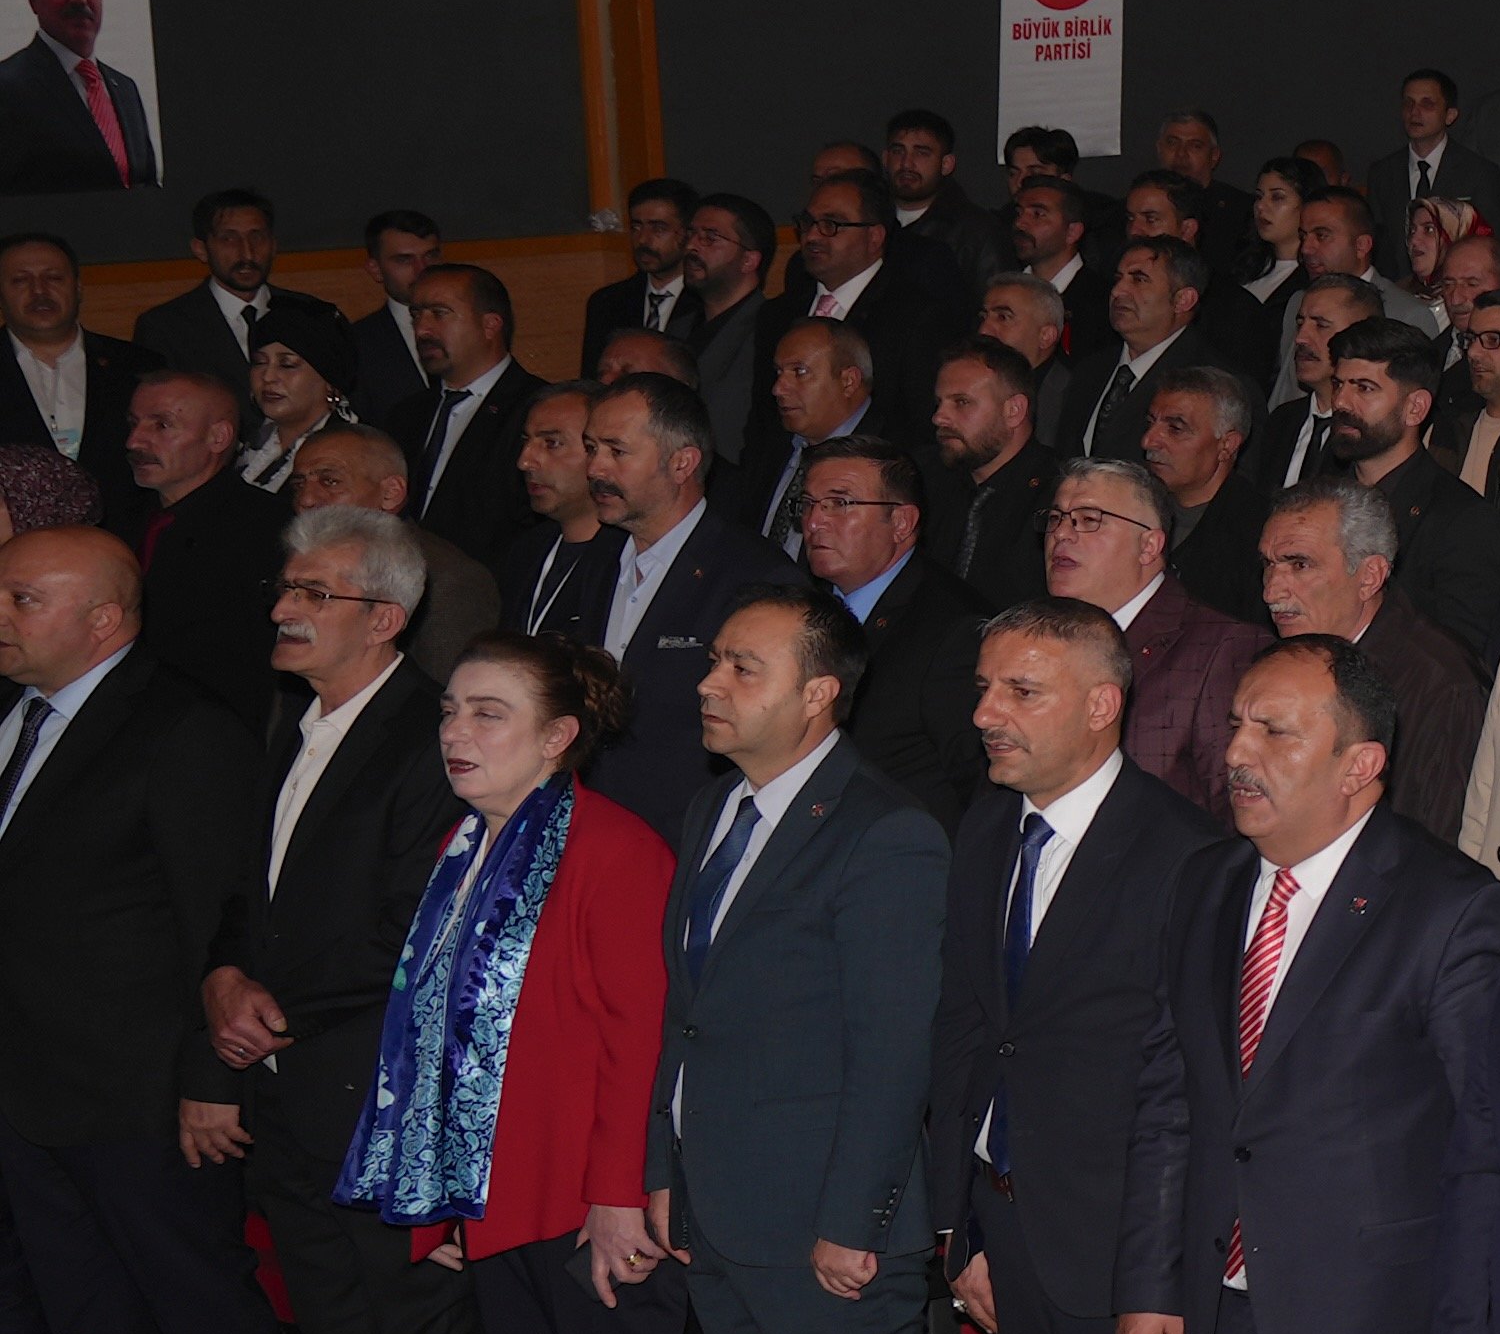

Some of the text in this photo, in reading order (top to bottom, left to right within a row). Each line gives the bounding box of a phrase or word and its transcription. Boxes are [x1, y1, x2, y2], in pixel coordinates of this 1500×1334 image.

[1012, 15, 1112, 40] BÜYÜK BİRLİK
[1035, 37, 1091, 62] PARTİSİ
